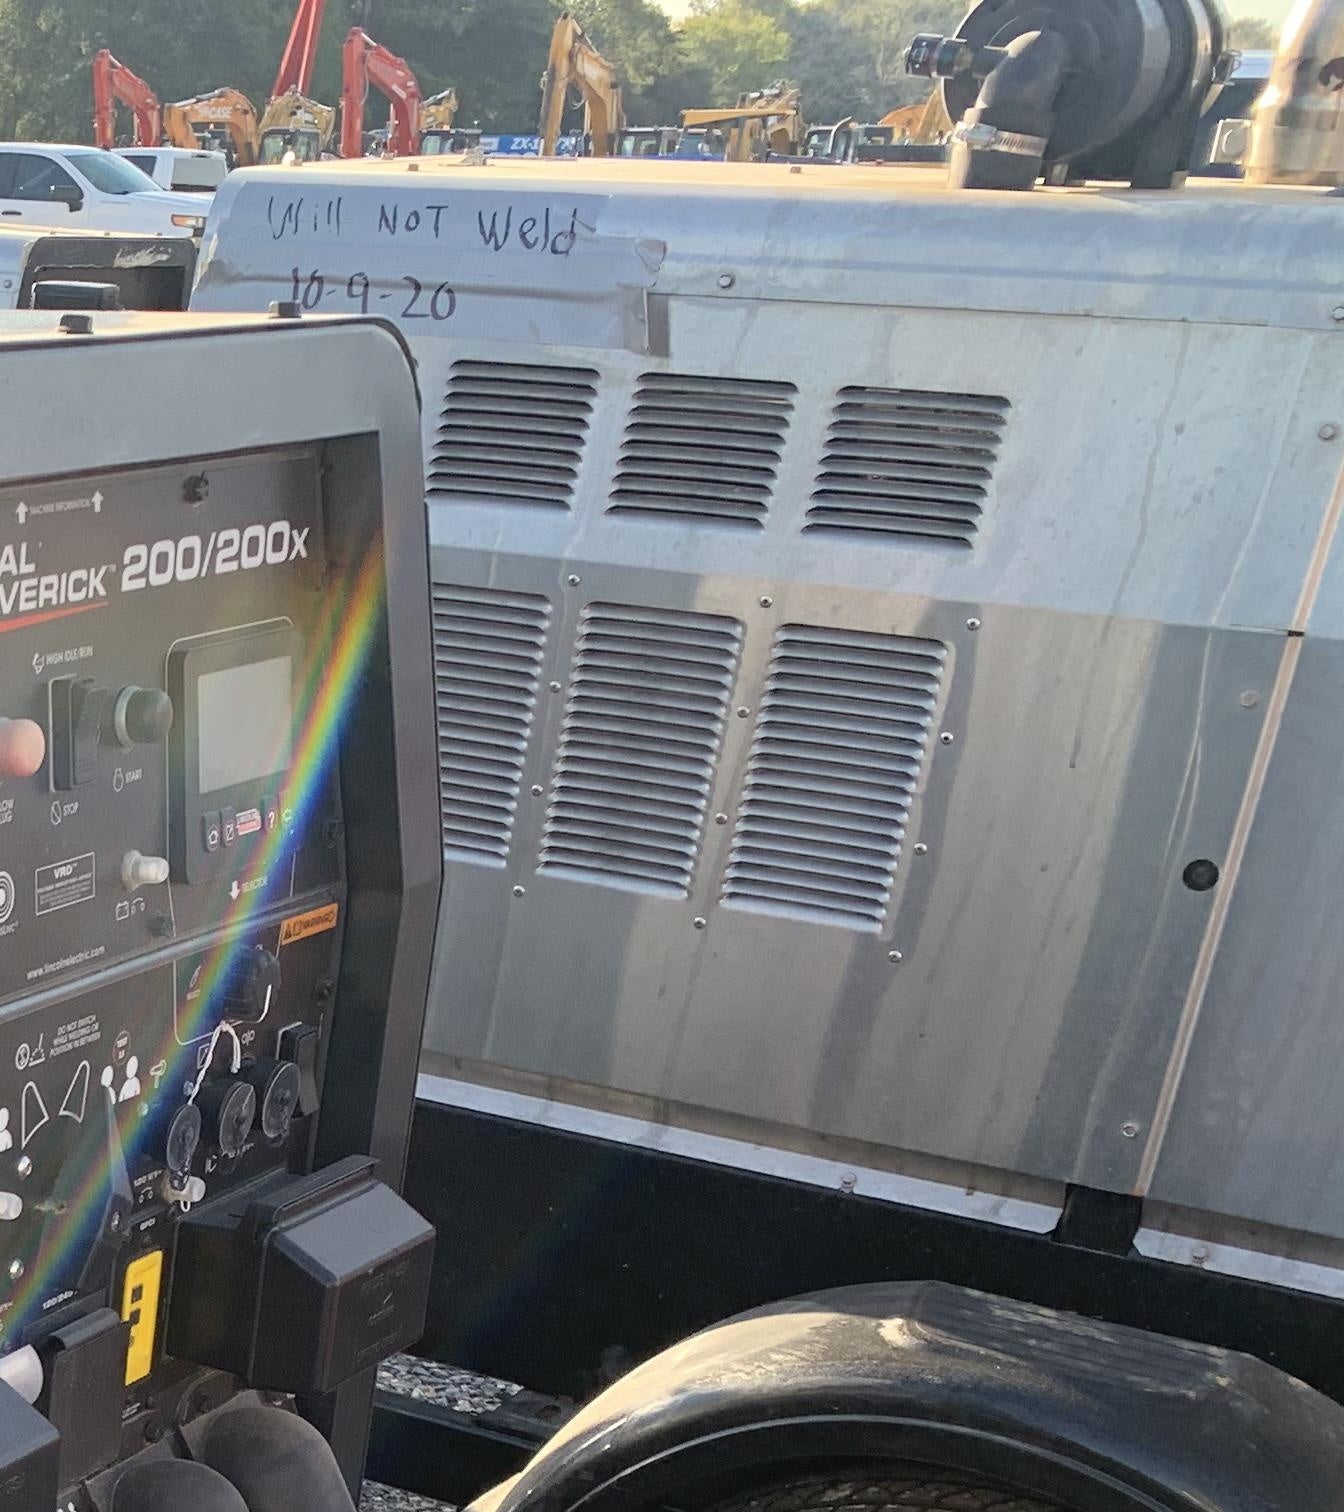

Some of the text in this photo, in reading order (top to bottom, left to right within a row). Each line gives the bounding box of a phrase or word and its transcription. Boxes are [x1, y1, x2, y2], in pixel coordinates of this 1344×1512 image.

[267, 196, 342, 241] Will
[478, 206, 578, 257] Weld
[291, 265, 457, 321] 10-9-20
[62, 801, 80, 817] STOP
[53, 864, 73, 879] VRD
